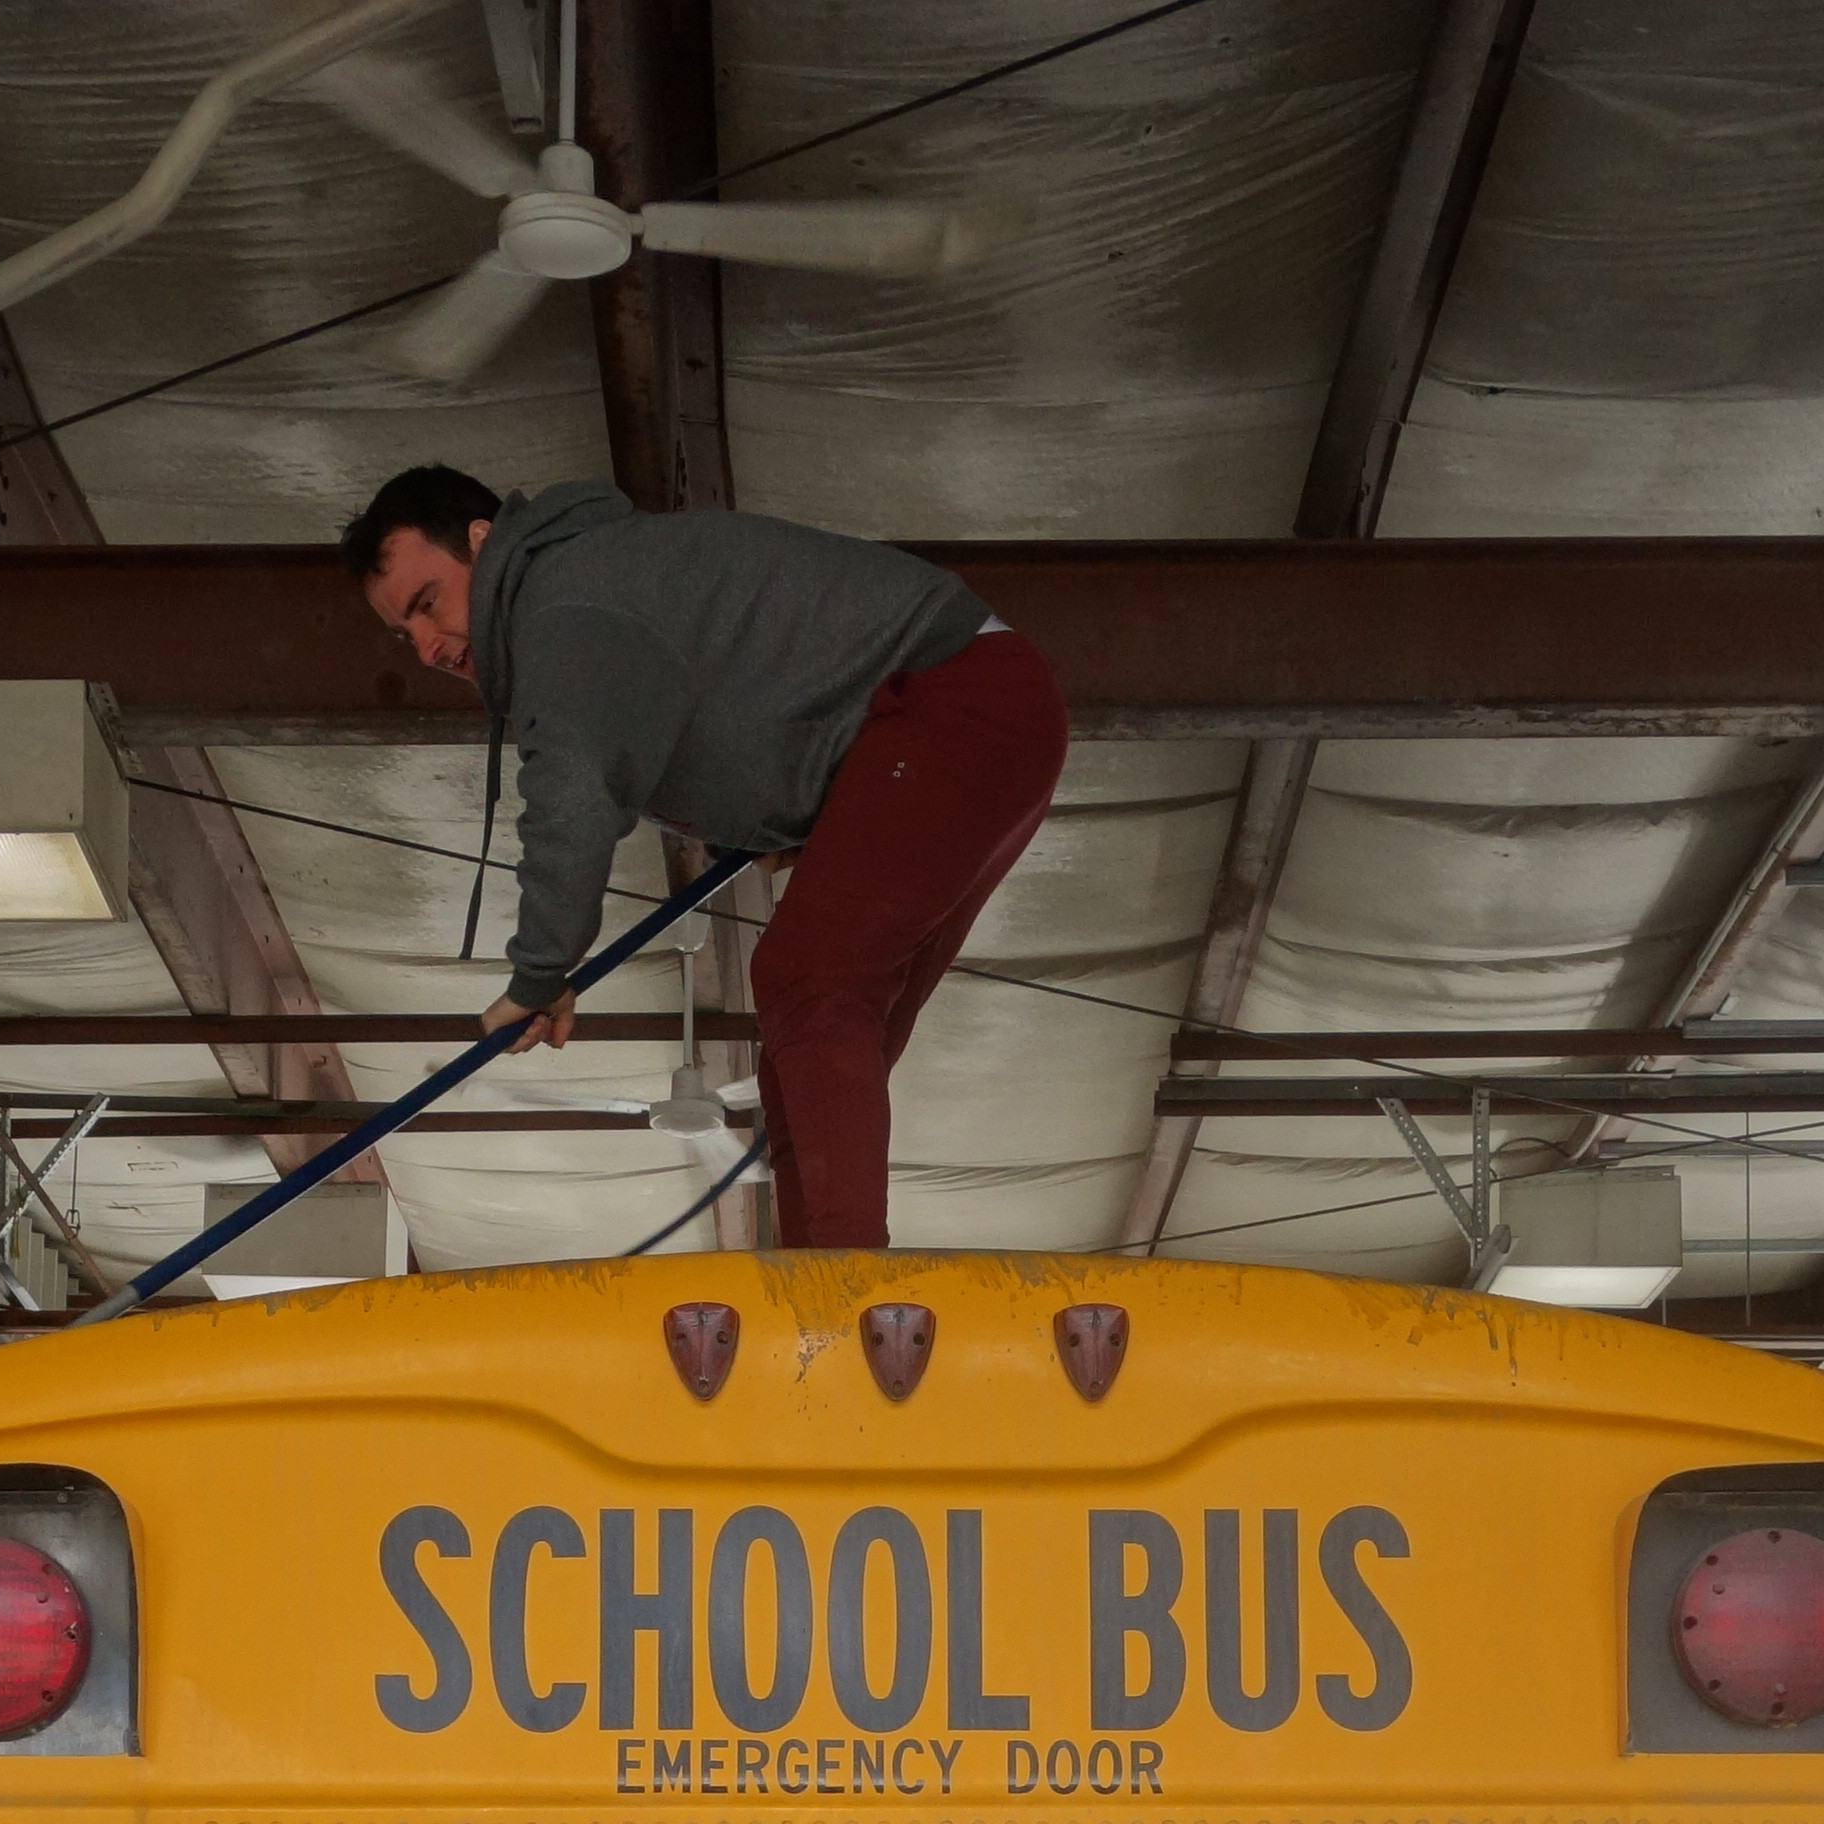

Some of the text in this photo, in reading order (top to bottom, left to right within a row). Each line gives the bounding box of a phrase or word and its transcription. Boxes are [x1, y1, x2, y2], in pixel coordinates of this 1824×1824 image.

[374, 1505, 1413, 1733] SCHOOL BUS
[615, 1738, 1163, 1794] EMERGENCY DOOR
